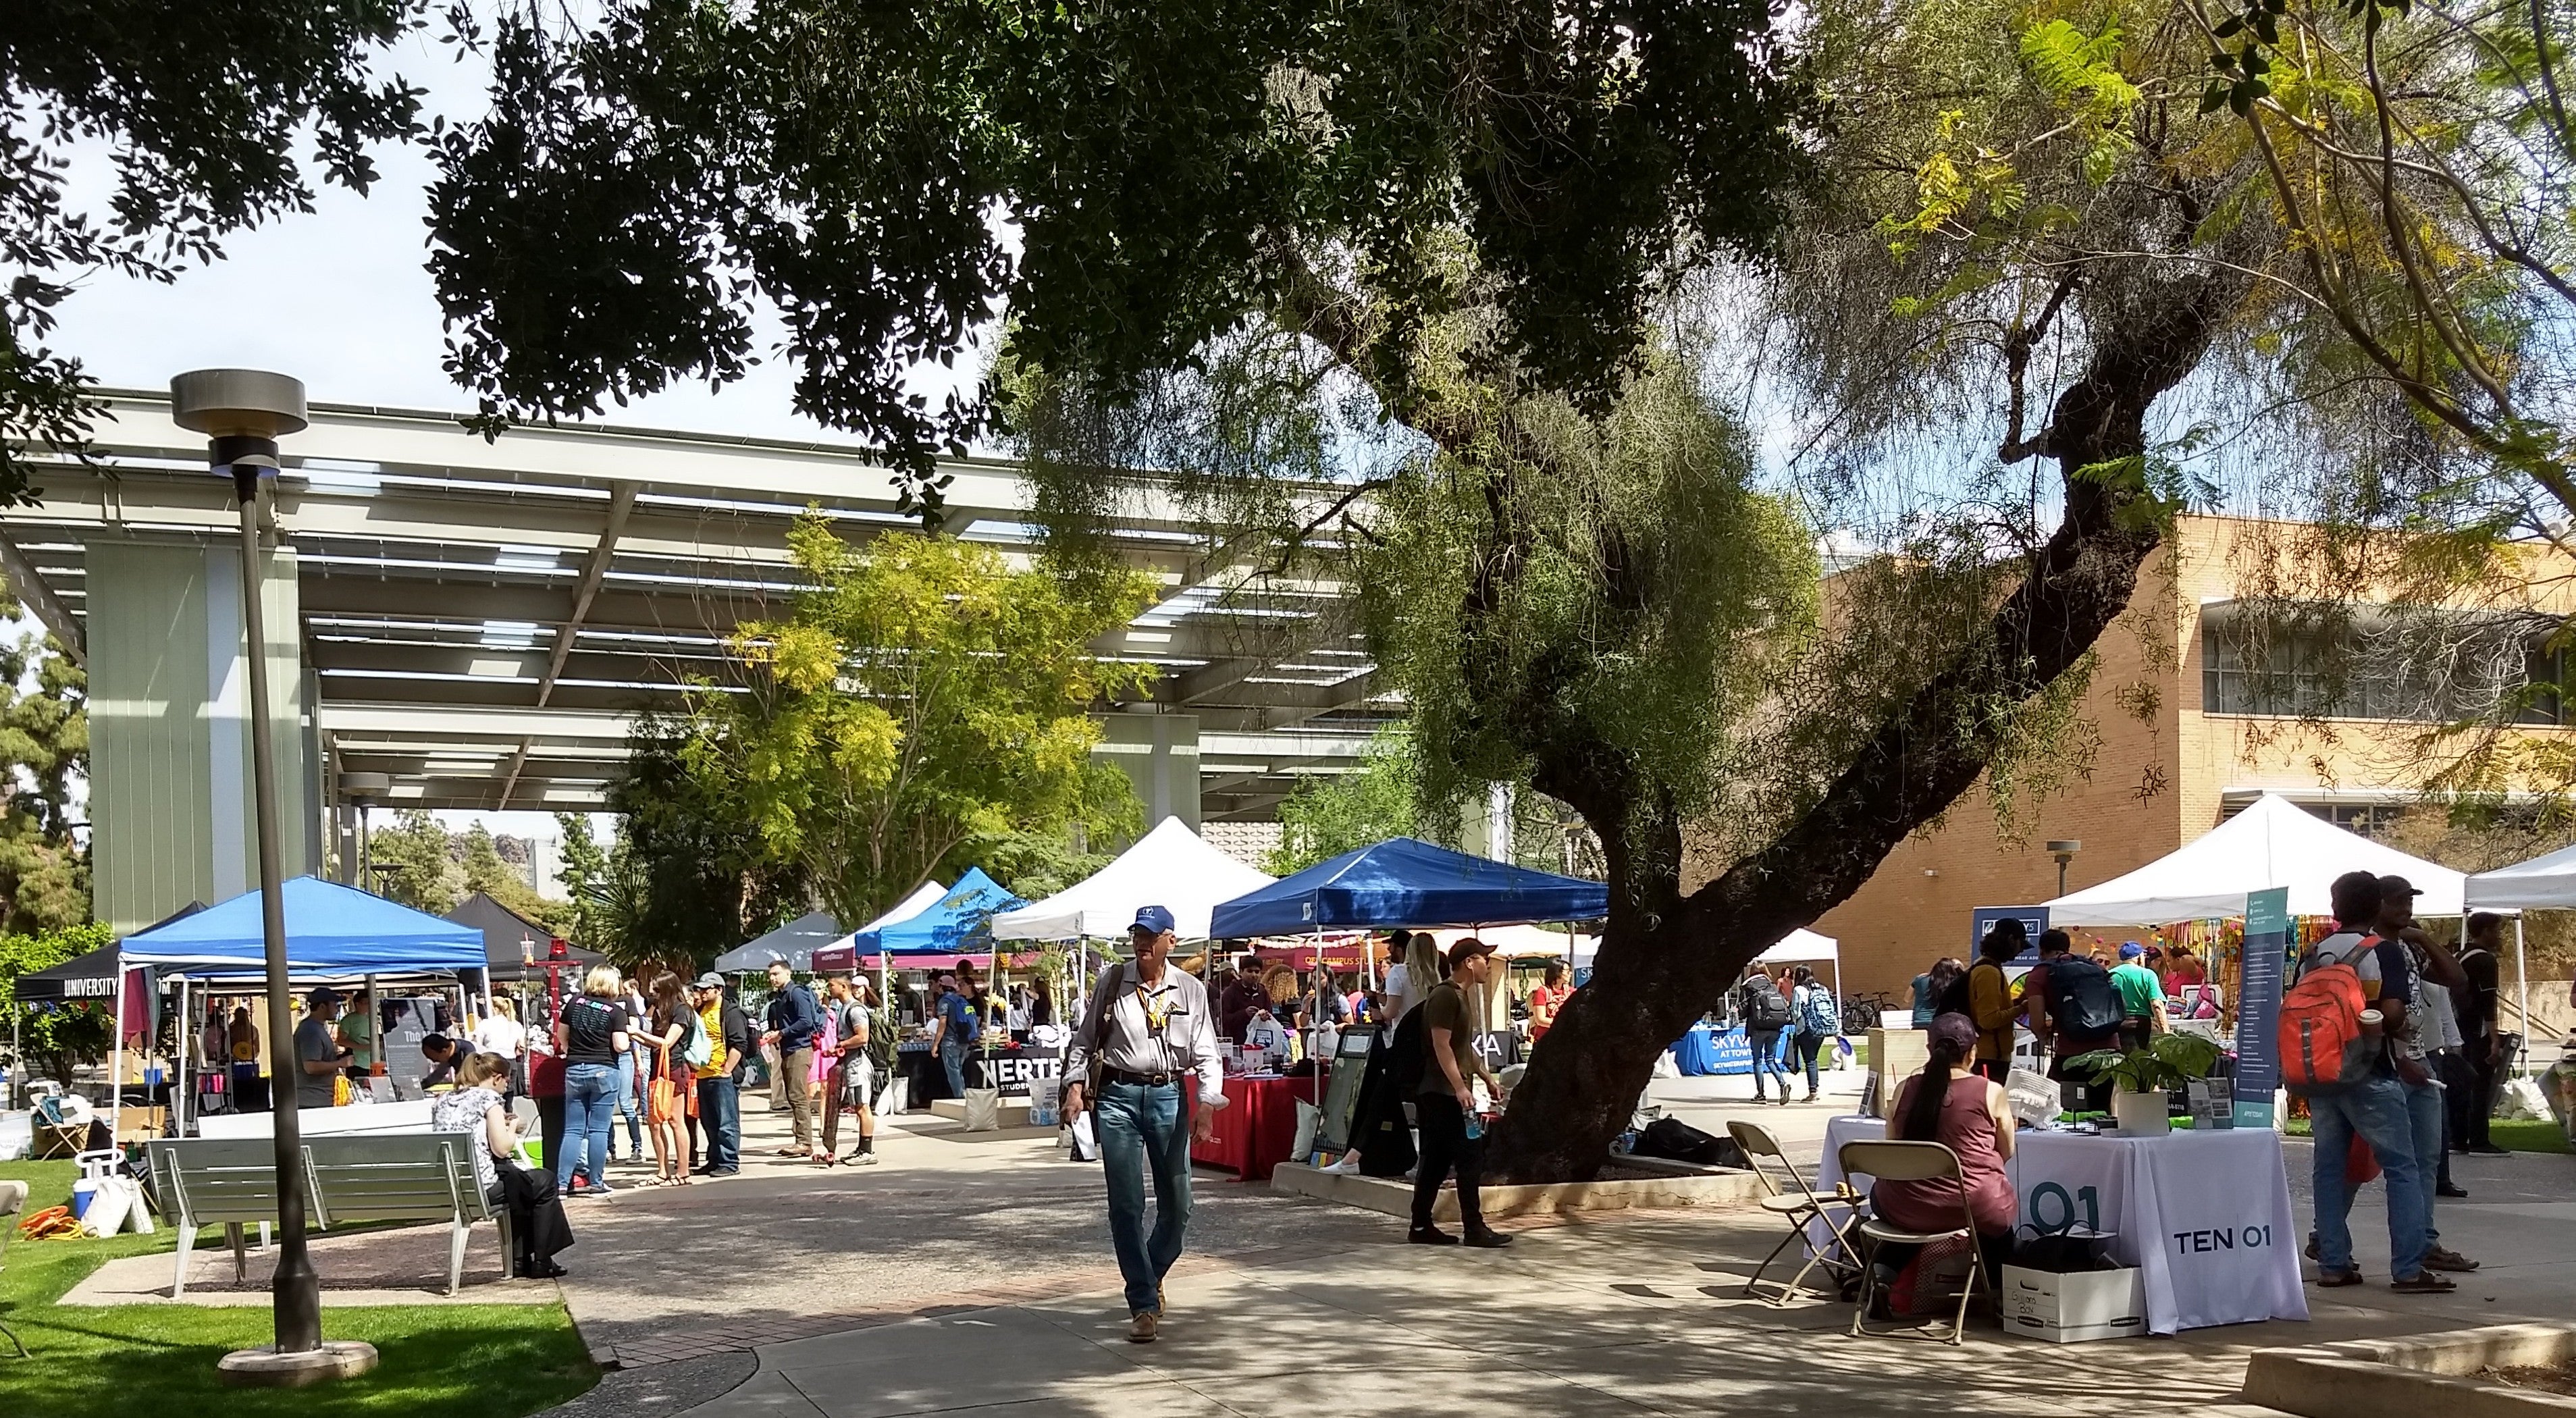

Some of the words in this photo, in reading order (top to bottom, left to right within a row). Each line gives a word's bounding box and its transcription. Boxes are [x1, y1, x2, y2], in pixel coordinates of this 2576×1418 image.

[1321, 957, 1354, 965] CAMPUS
[64, 977, 118, 997] UNIVERSITY
[1720, 1050, 1730, 1058] AT
[2174, 1228, 2234, 1254] TEN
